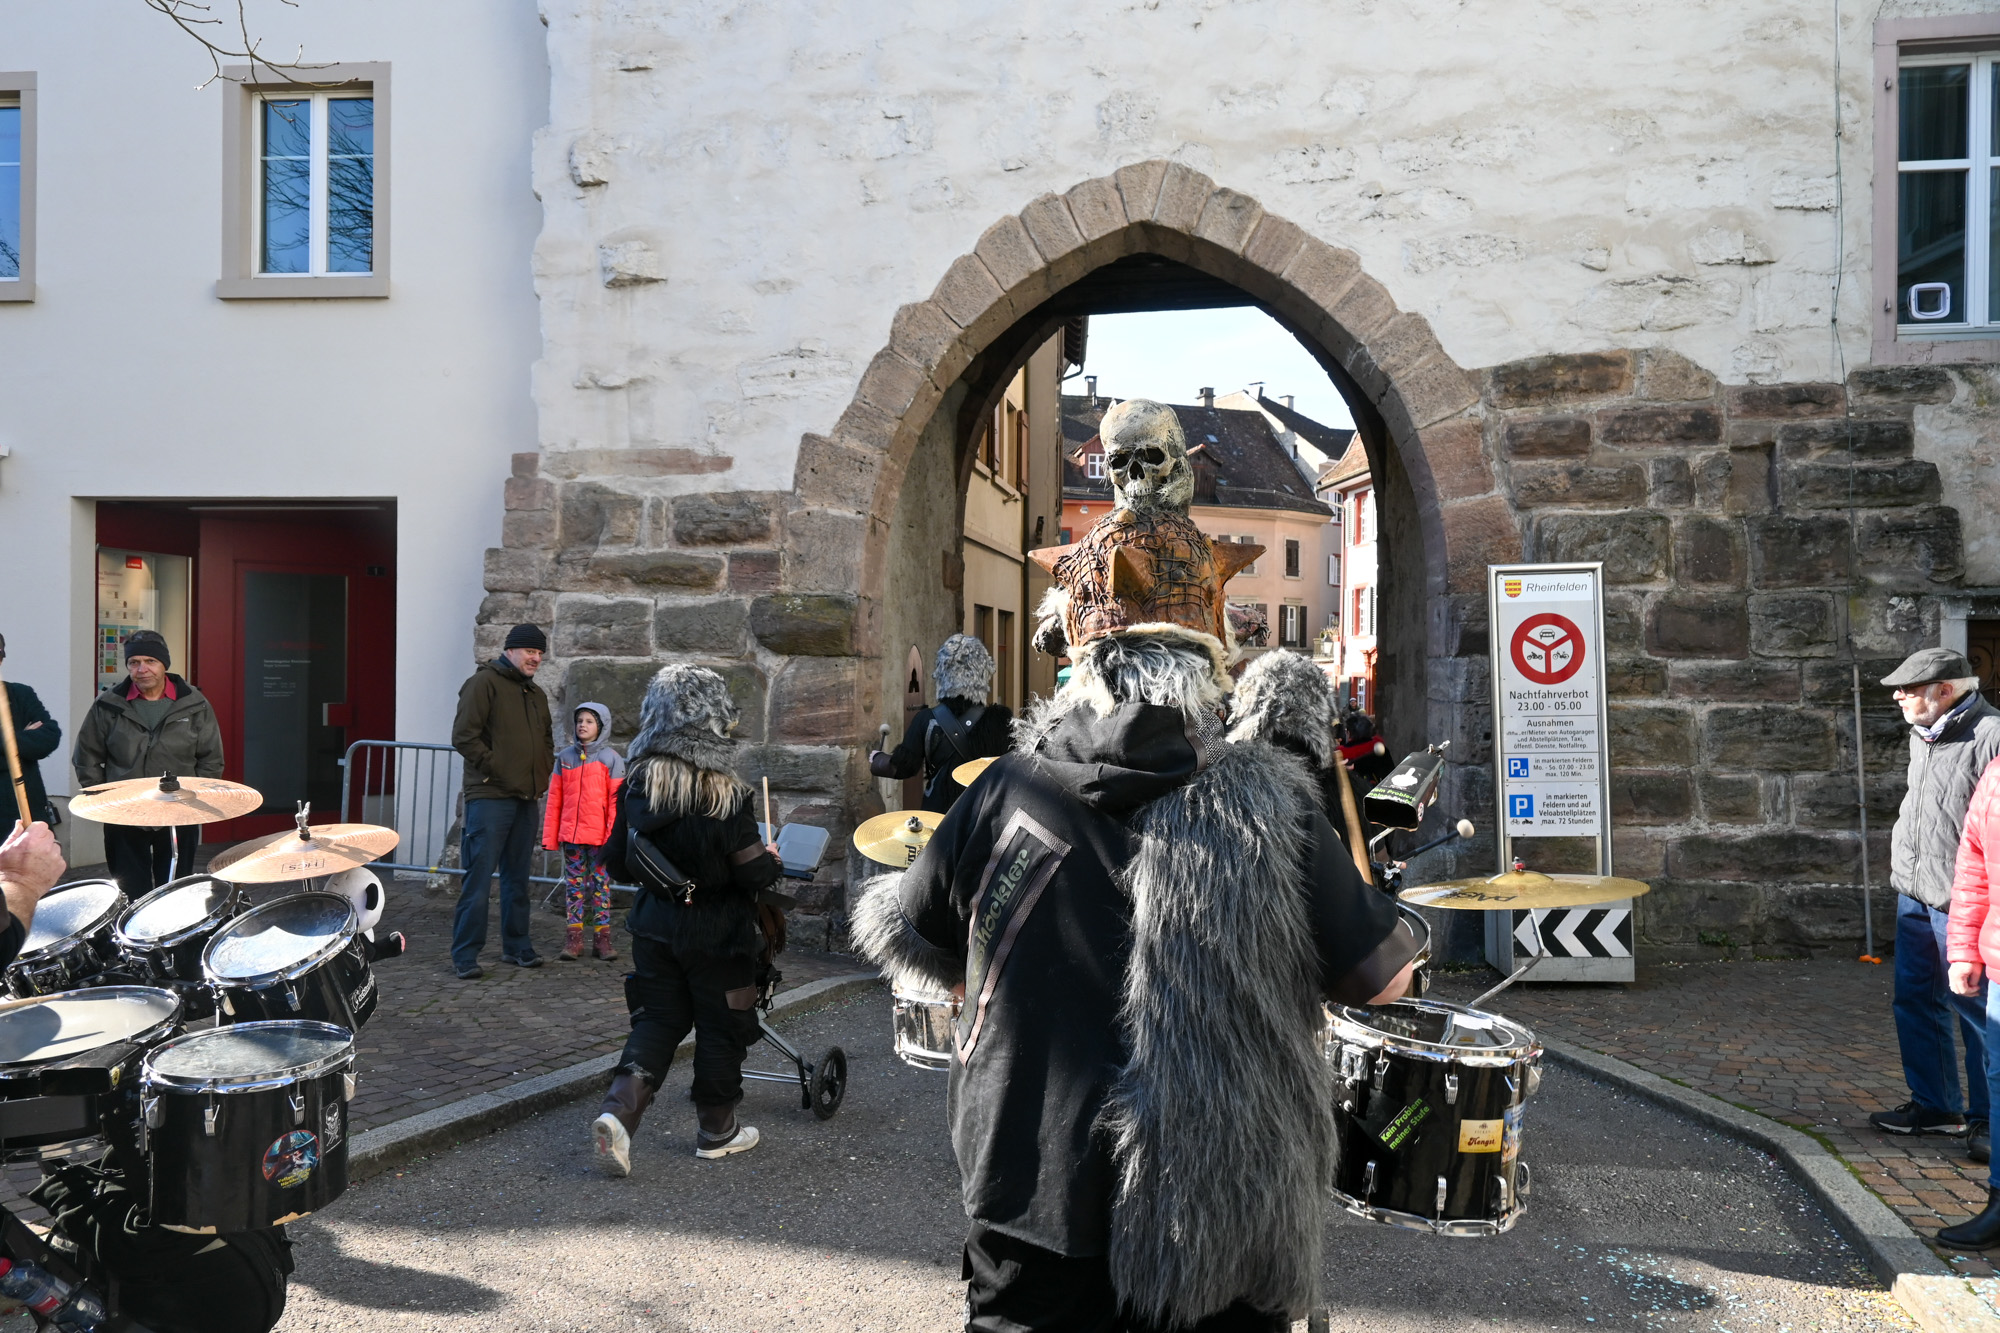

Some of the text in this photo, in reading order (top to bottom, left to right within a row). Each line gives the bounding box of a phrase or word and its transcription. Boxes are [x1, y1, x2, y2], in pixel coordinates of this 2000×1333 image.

[1526, 582, 1588, 592] Rheinfelden
[1509, 689, 1589, 700] Nachtfahrverbot
[1517, 701, 1545, 711] 23.00
[1554, 701, 1582, 711] 05.00
[1526, 719, 1574, 727] Ausnahmen
[1559, 729, 1595, 737] Autogaragen
[1510, 759, 1521, 775] P
[1515, 797, 1528, 816] P
[1539, 809, 1597, 818] Veloabstellplätzen
[1380, 1098, 1423, 1142] Kein Problem
[1389, 1106, 1430, 1150] meiner Stufe
